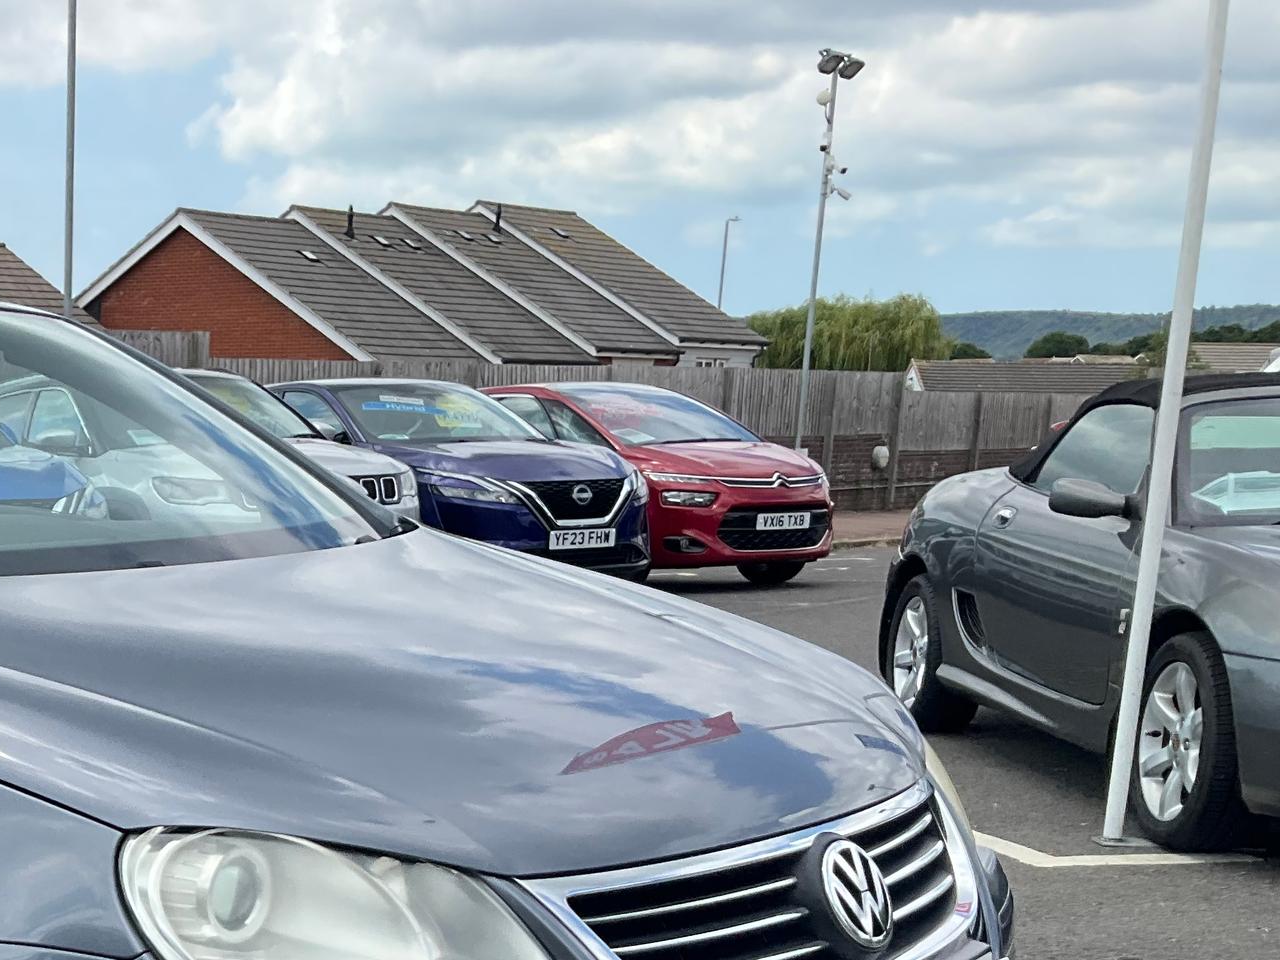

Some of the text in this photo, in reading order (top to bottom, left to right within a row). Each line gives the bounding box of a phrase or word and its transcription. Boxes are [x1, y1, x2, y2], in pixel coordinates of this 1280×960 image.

[763, 514, 805, 528] VX16 TXB
[554, 530, 611, 547] YF23 FHW
